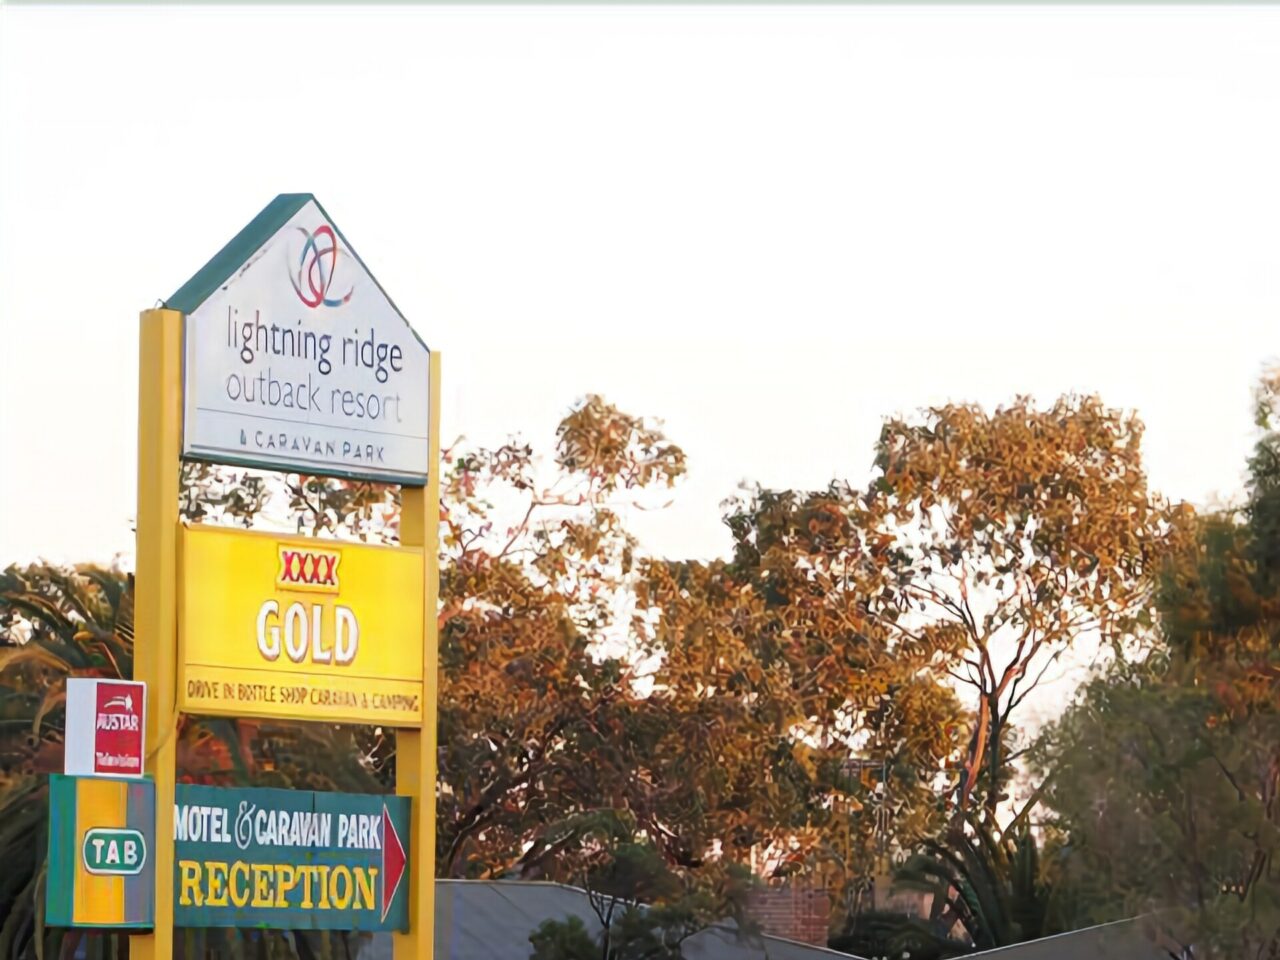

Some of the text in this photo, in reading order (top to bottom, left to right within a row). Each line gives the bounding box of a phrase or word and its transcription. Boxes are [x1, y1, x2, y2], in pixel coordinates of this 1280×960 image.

[228, 305, 403, 383] lightning ridge
[227, 367, 402, 422] outback resort
[255, 430, 335, 455] CARAVAN
[342, 441, 384, 462] PARK
[281, 551, 337, 586] XXXX
[256, 599, 360, 667] GOLD
[174, 800, 382, 849] MOTEL & CARAVAN PARK
[92, 838, 138, 865] TAB
[179, 860, 379, 910] RECEPTION
